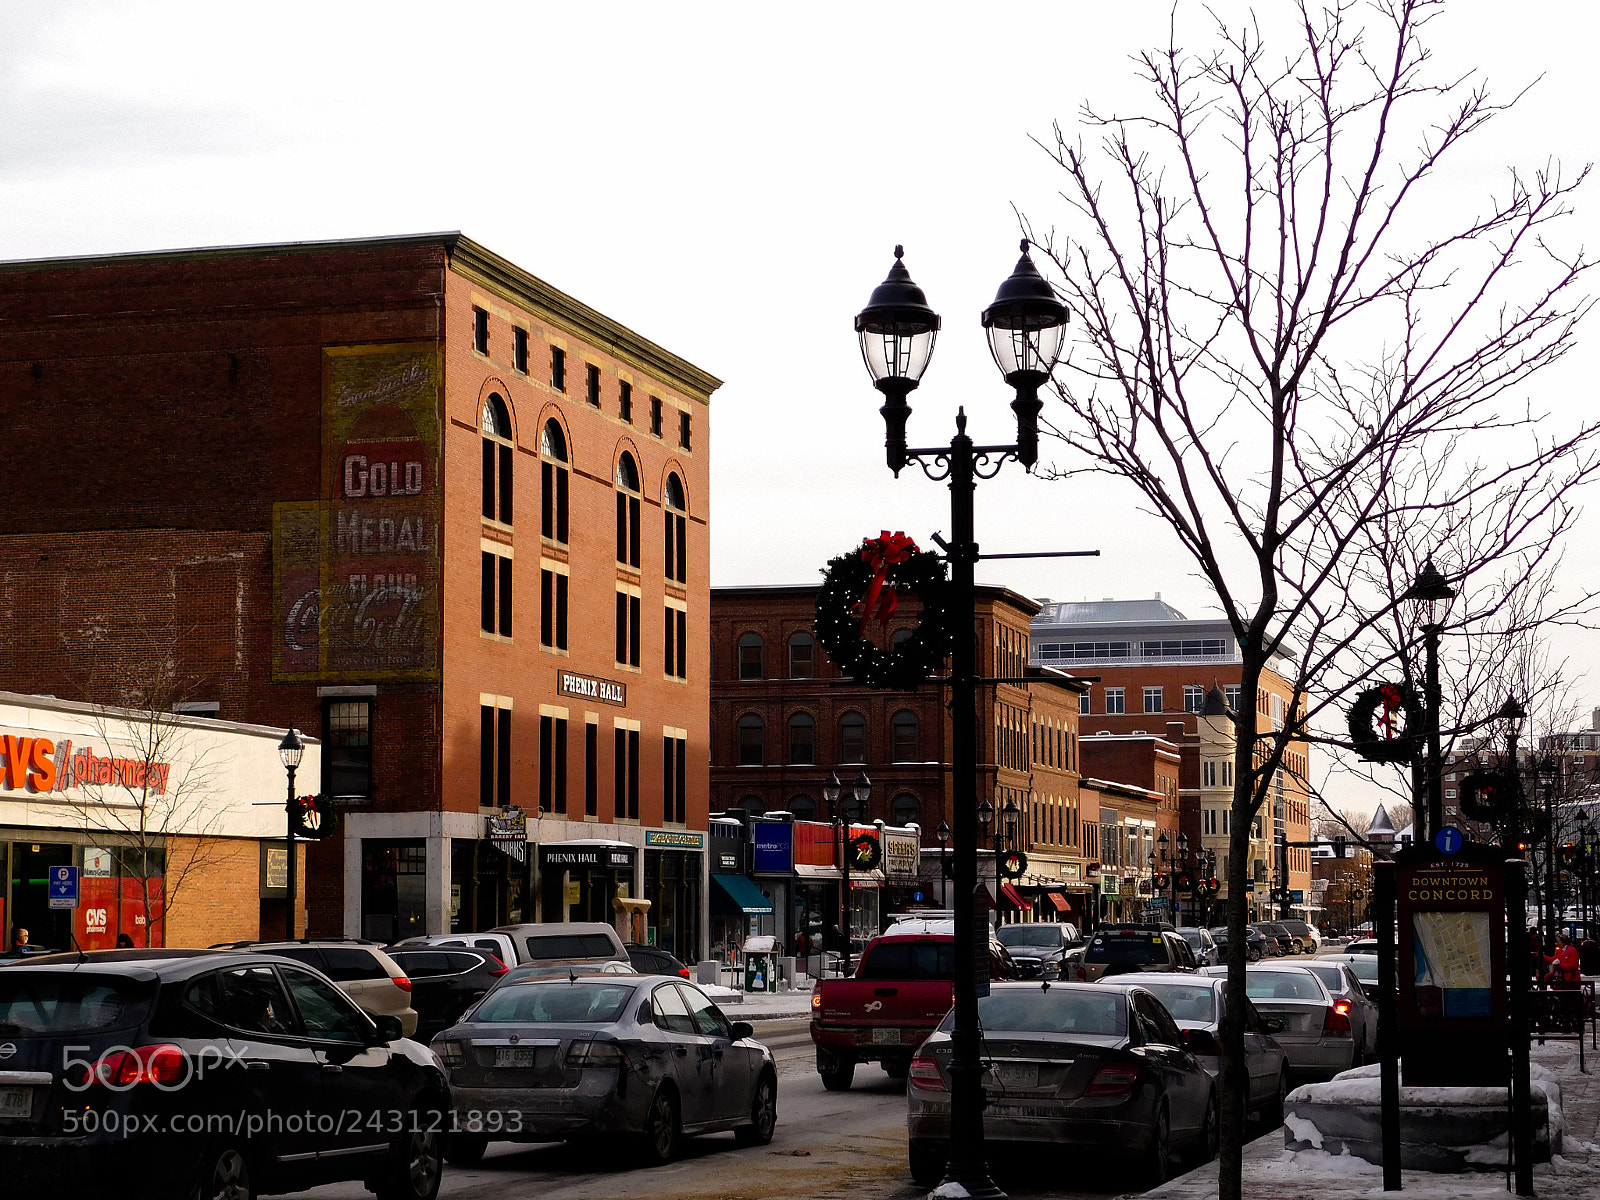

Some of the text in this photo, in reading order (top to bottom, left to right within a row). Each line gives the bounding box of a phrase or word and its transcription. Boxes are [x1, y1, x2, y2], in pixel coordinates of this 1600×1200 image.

[344, 454, 423, 498] GOLD
[337, 510, 430, 553] MEDAL
[561, 674, 623, 702] PHENIX HALL
[73, 746, 170, 795] pharmacy
[500, 840, 524, 863] WORKS
[756, 842, 790, 850] metroPCS
[546, 853, 598, 863] PHENIX HALL
[1412, 877, 1488, 886] DOWNTOWN
[1408, 889, 1493, 900] CONCORD
[86, 908, 107, 926] CVS
